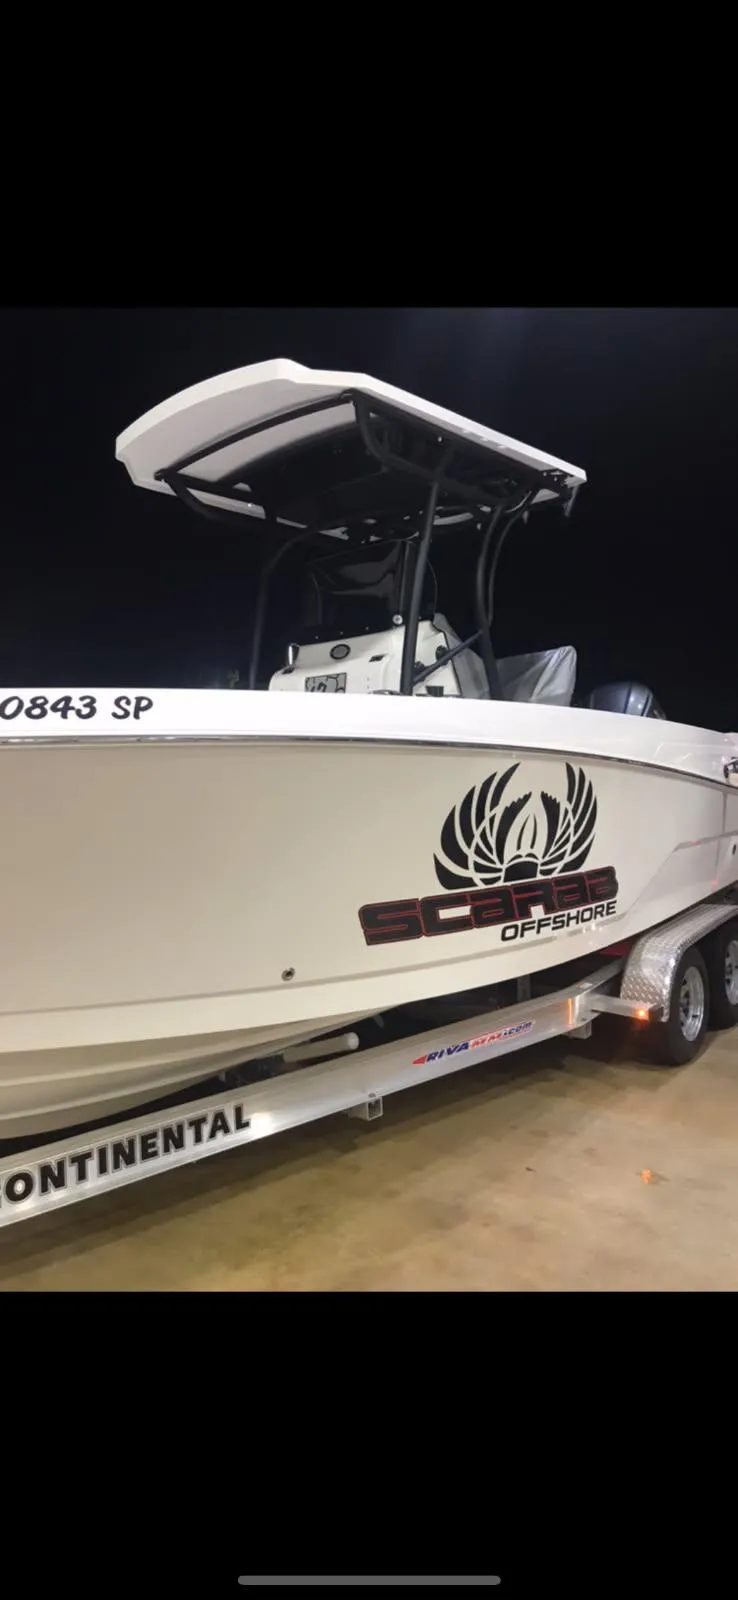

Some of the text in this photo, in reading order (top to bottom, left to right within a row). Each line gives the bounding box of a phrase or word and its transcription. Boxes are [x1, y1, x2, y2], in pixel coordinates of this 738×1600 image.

[0, 695, 154, 720] 0843 SP
[500, 900, 617, 942] OFFSHORE
[0, 1103, 251, 1208] ONTINENTAL
